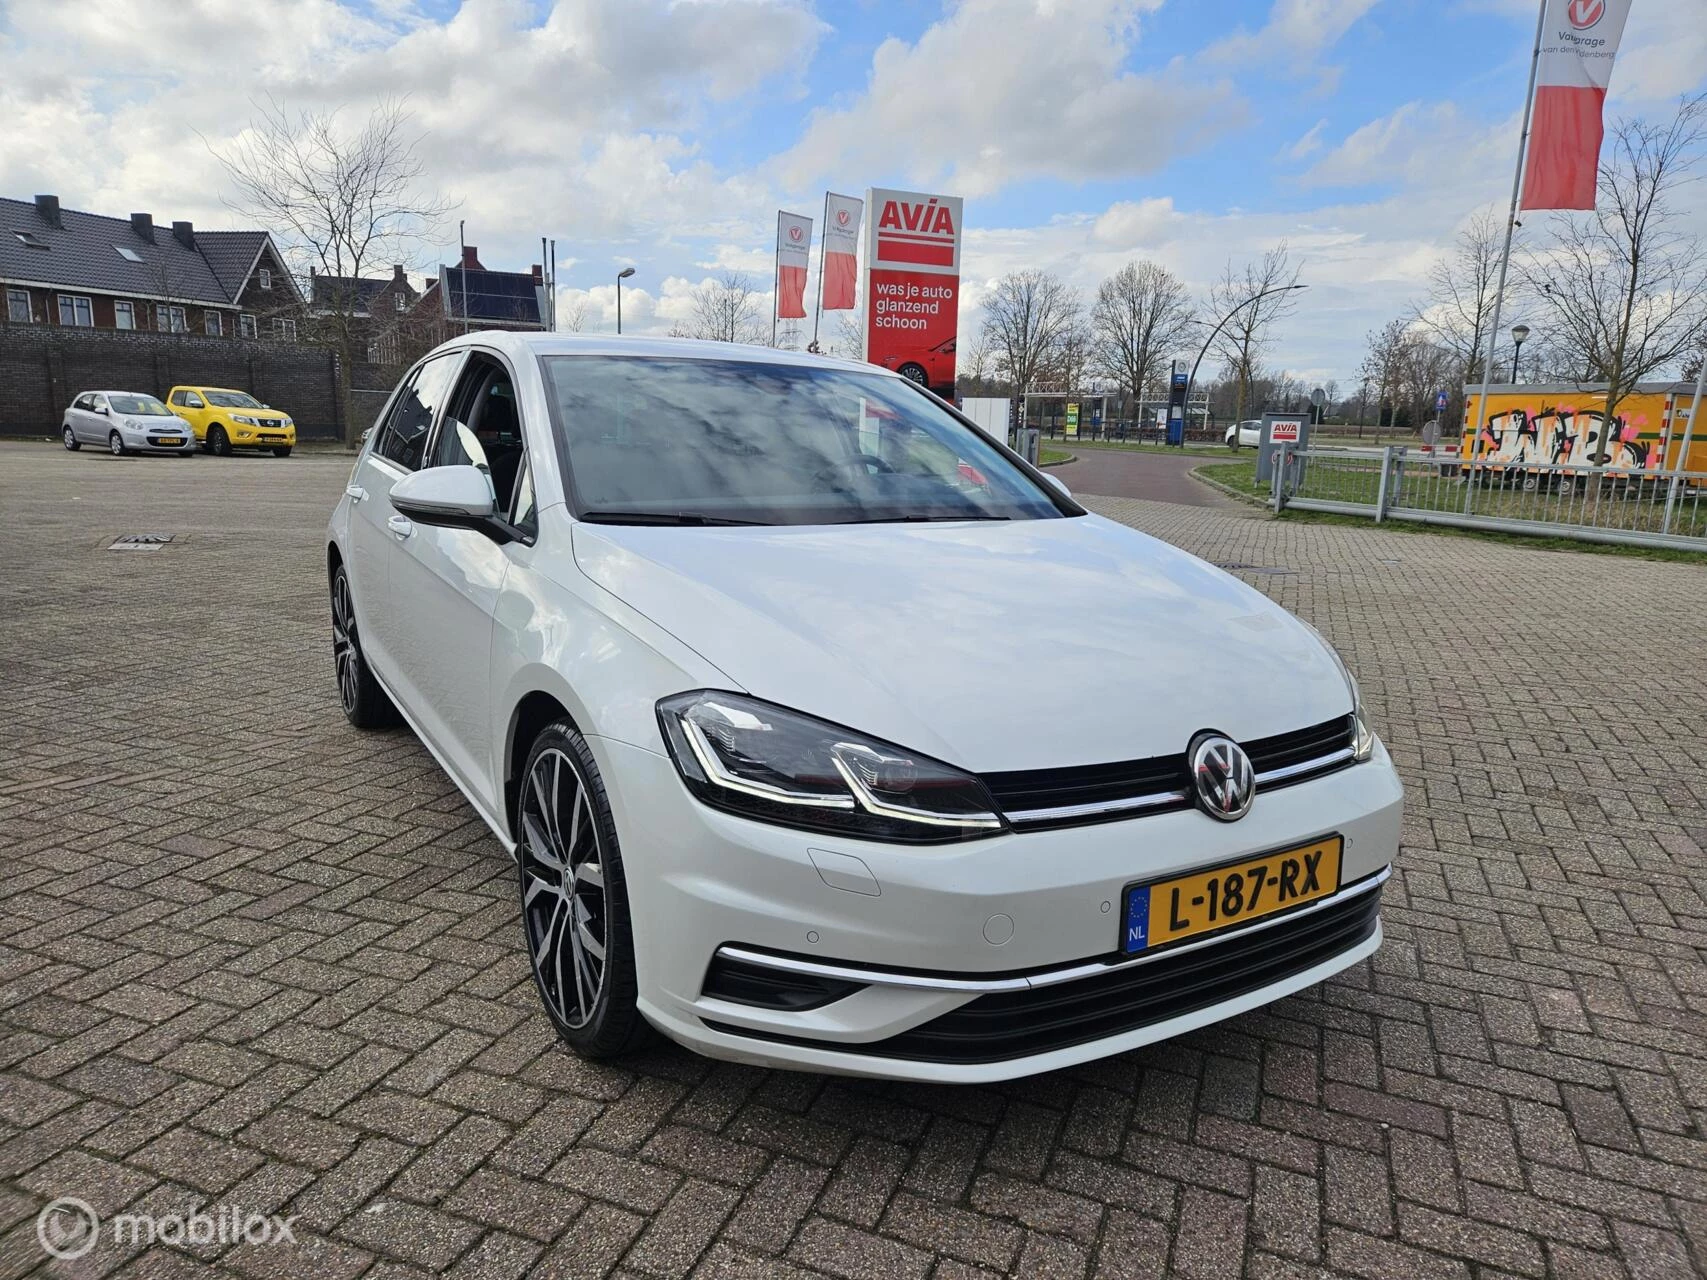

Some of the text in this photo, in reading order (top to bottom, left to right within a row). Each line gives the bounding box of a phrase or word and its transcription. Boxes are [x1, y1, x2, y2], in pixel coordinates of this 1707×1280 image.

[879, 198, 954, 235] AVIA
[877, 283, 952, 299] was je auto
[876, 298, 939, 314] glanzend
[875, 314, 927, 330] schoon
[1274, 422, 1297, 432] AVIA
[1169, 851, 1322, 931] L-187-RX
[1129, 925, 1145, 941] NL
